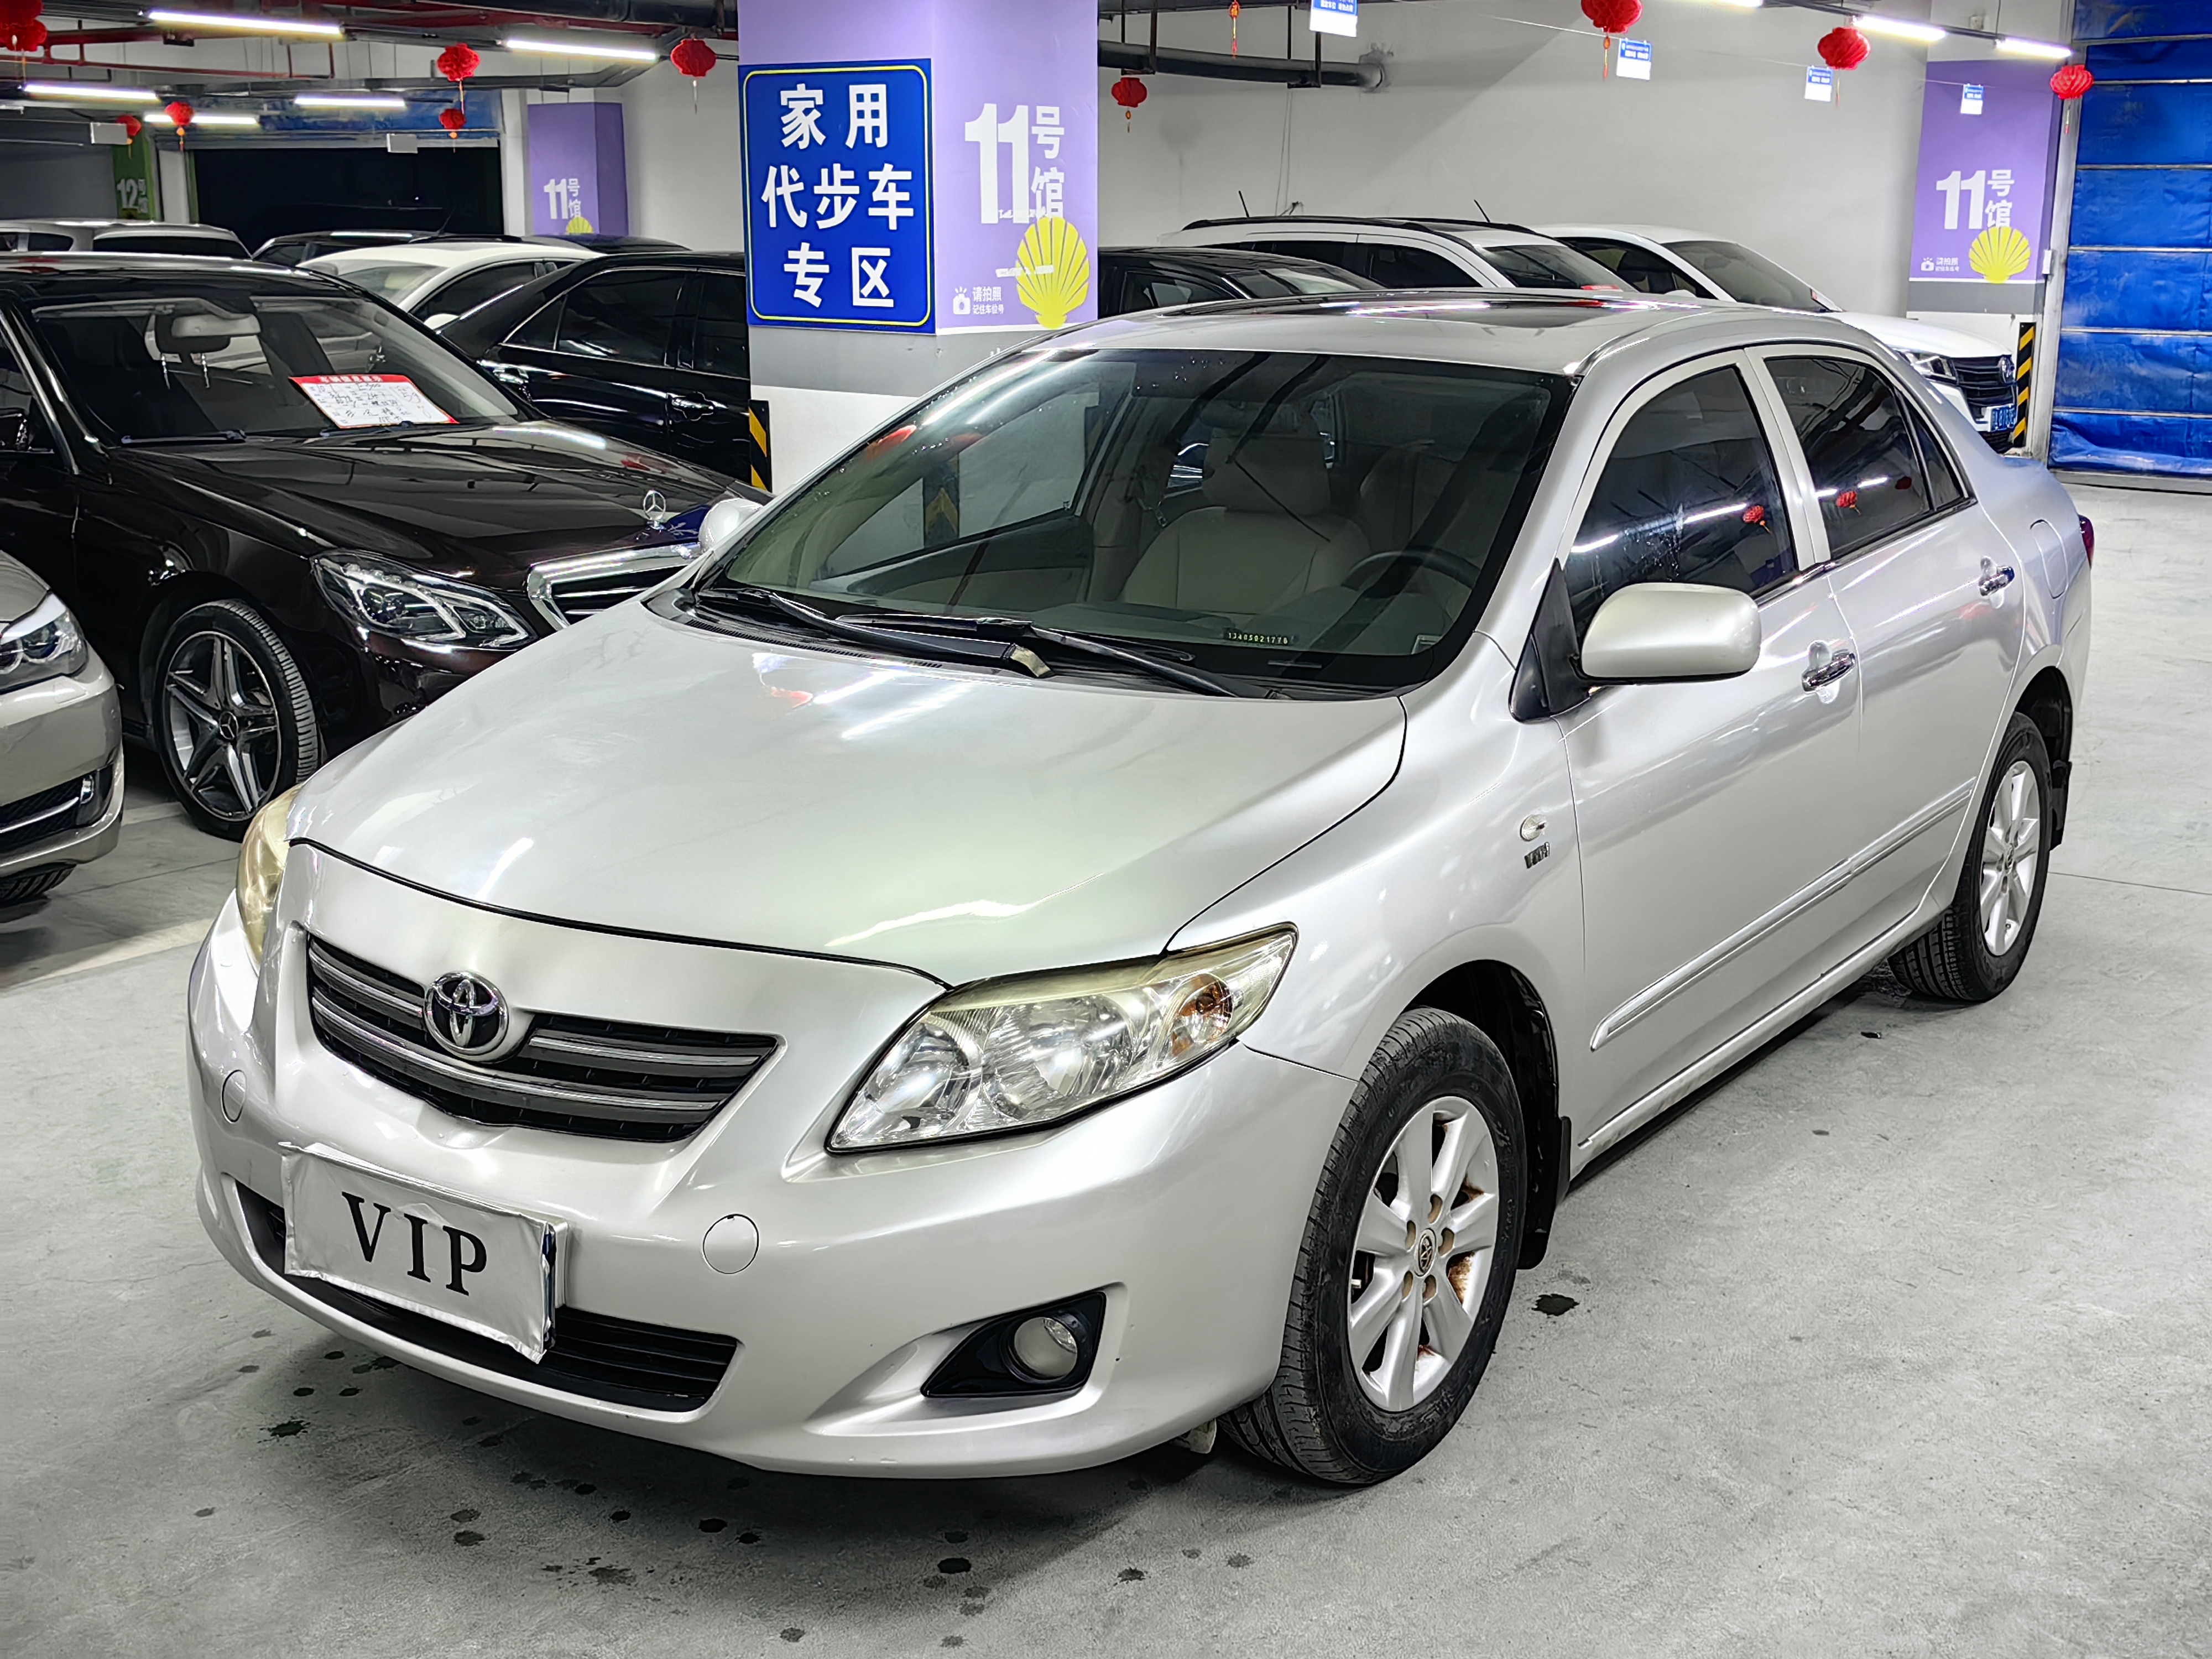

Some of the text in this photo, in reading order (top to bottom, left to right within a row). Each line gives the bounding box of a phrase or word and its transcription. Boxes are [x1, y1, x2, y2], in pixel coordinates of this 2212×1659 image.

[780, 83, 888, 150] 家用
[761, 163, 914, 230] 代步车
[964, 103, 1029, 224] 11
[544, 178, 568, 220] 11
[1936, 170, 1986, 230] 11
[783, 242, 894, 308] 专区
[972, 286, 1002, 302] 请拍照
[341, 1191, 487, 1296] VIP
